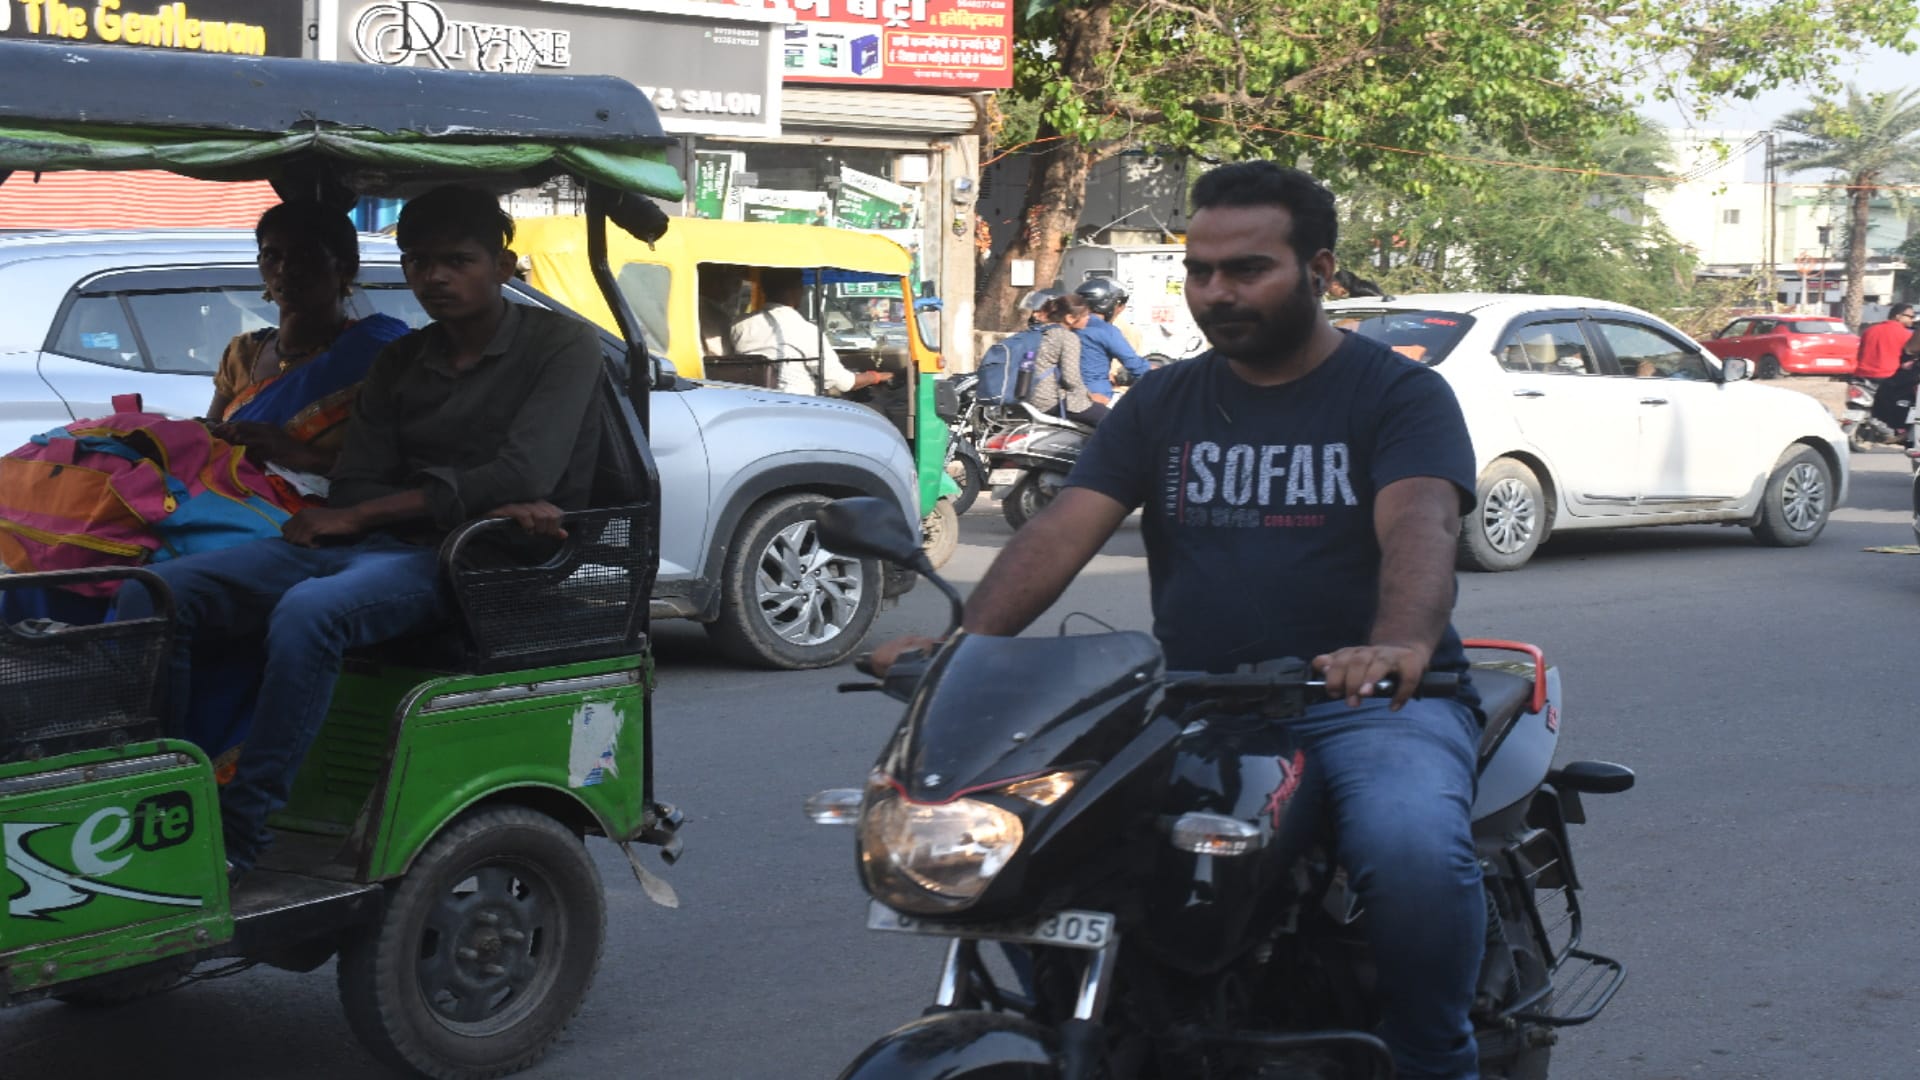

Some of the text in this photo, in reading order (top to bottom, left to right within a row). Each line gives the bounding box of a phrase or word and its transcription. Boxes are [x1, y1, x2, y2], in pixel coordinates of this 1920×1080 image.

[18, 0, 88, 39] The
[94, 0, 266, 56] Gentleman
[656, 87, 677, 110] &
[681, 90, 761, 115] SALON
[1186, 441, 1359, 506] SOFAR
